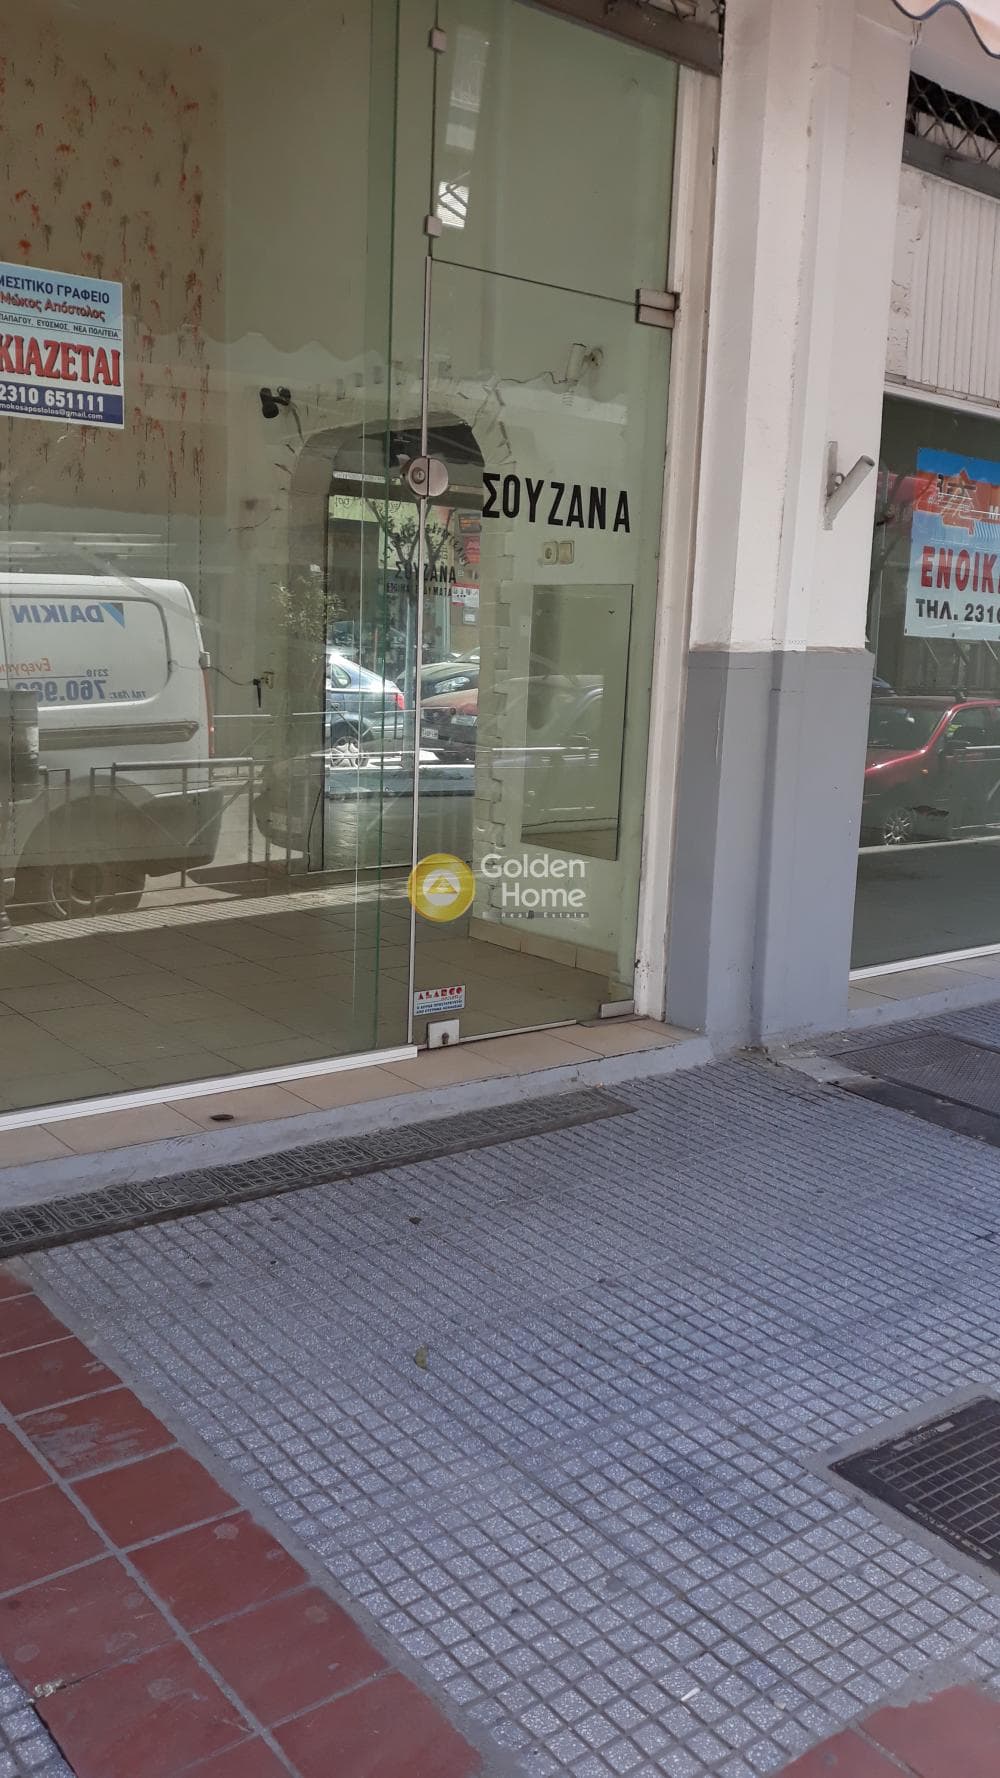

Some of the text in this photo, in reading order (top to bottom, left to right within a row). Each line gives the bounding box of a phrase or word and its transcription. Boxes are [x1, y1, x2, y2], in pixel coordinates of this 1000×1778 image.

[57, 284, 110, 304] ΓΡΑΦΕΙΟ
[45, 299, 106, 322] Απόστολος
[73, 325, 87, 334] ΝΕΑ
[88, 328, 119, 338] ΠΟΛΙΤΕΙΑ
[0, 383, 104, 413] 2310 651111
[482, 472, 631, 534] ΣΟΥΖΑΝΑ
[920, 545, 1000, 595] ΕΝΟΙΚ
[915, 598, 959, 621] ΤΗΛ.
